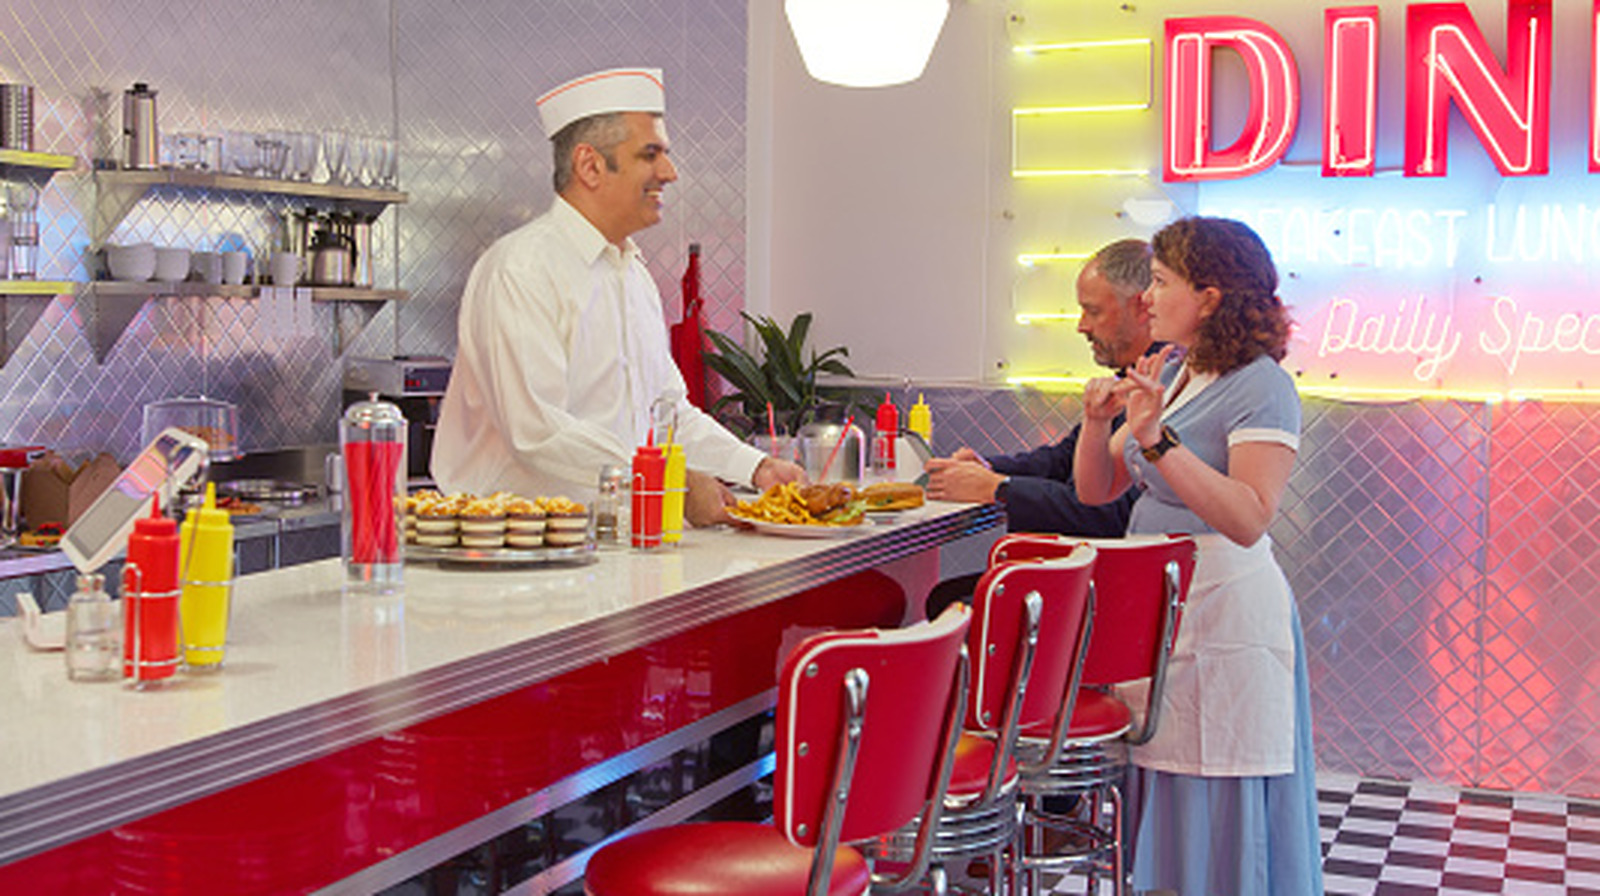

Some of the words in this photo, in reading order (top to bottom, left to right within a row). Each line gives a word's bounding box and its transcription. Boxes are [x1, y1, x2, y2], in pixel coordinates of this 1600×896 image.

[1163, 0, 1600, 183] DIN
[1200, 207, 1468, 268] EAKFAST
[1318, 294, 1461, 381] Daily
